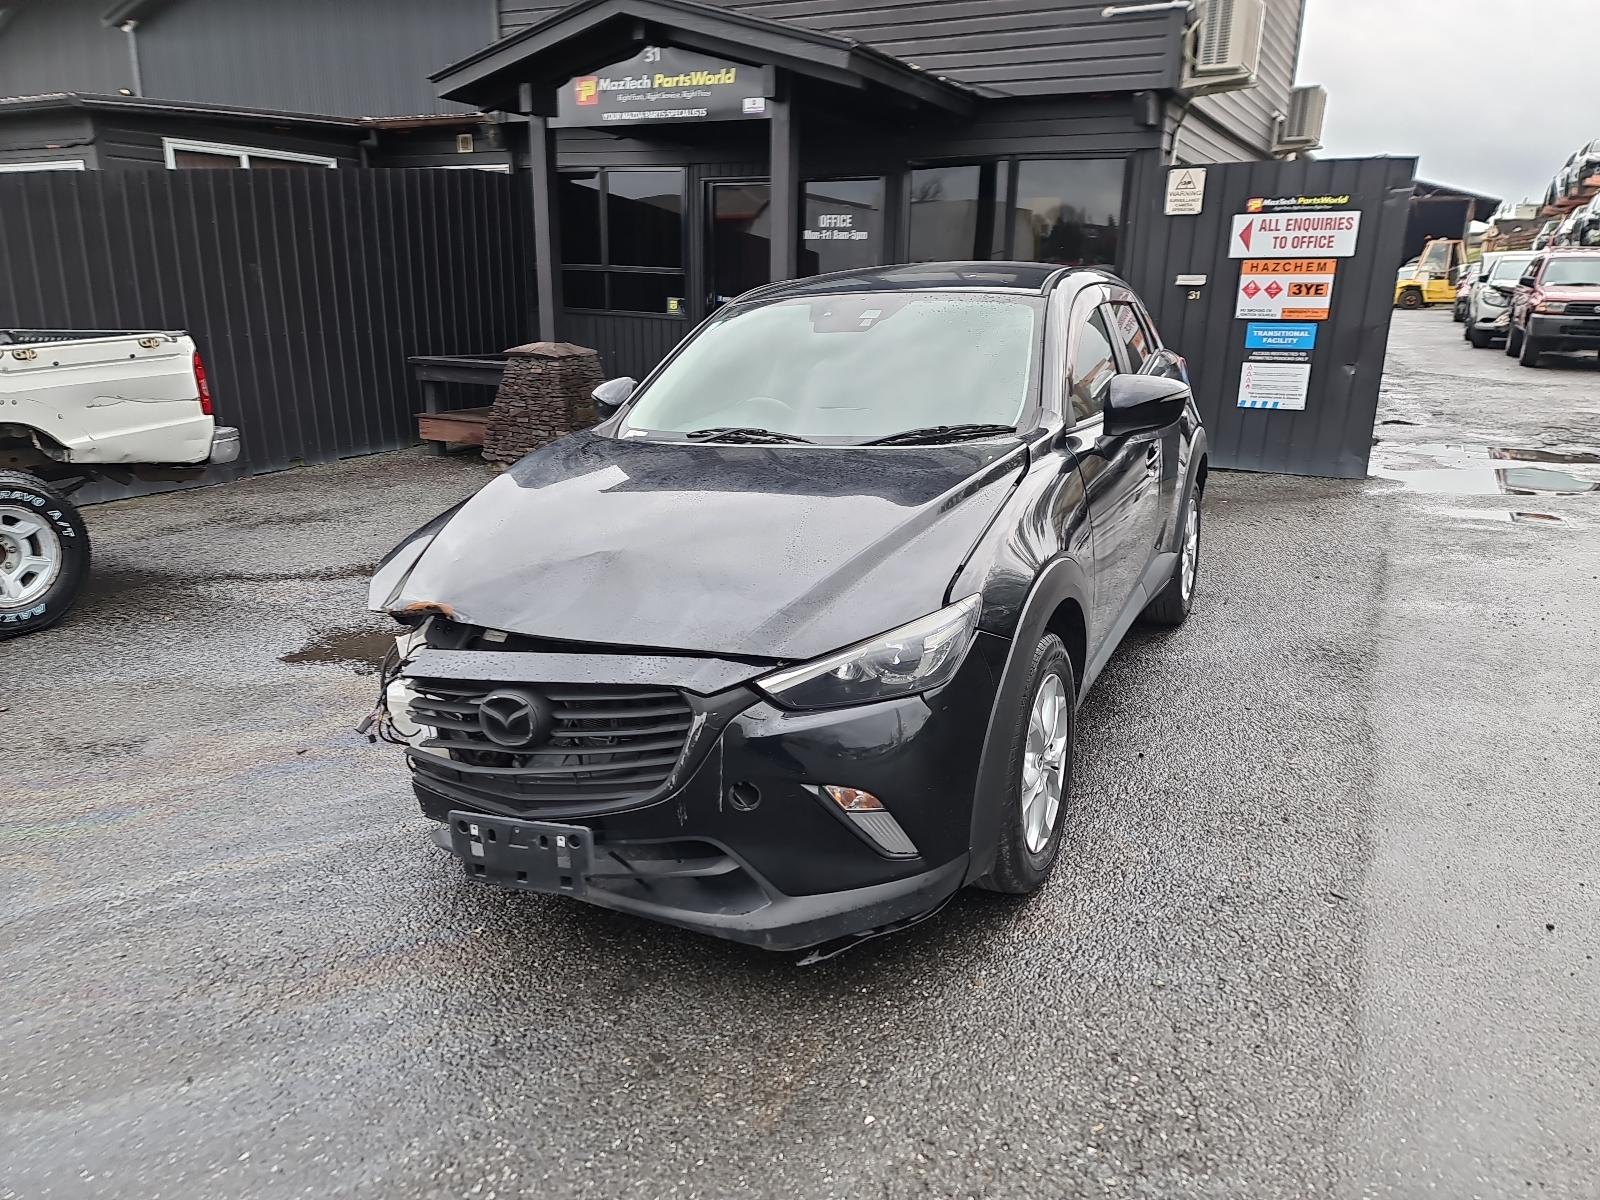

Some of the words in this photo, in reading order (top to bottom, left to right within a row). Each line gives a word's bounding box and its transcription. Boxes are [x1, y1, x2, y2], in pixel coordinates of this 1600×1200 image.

[643, 45, 661, 62] 31
[600, 74, 651, 90] MazTech
[653, 68, 736, 88] PartsWorld
[1297, 195, 1350, 205] PartsWorld
[818, 214, 853, 228] OFFICE
[1259, 218, 1281, 232] ALL
[1285, 216, 1355, 232] ENQUIRIES
[803, 229, 832, 240] Mon-Fri
[1273, 236, 1288, 249] TO
[1291, 235, 1335, 249] OFFICE
[1250, 262, 1328, 272] HAZCHEM
[1187, 290, 1200, 300] 31
[1292, 284, 1324, 295] 3YE
